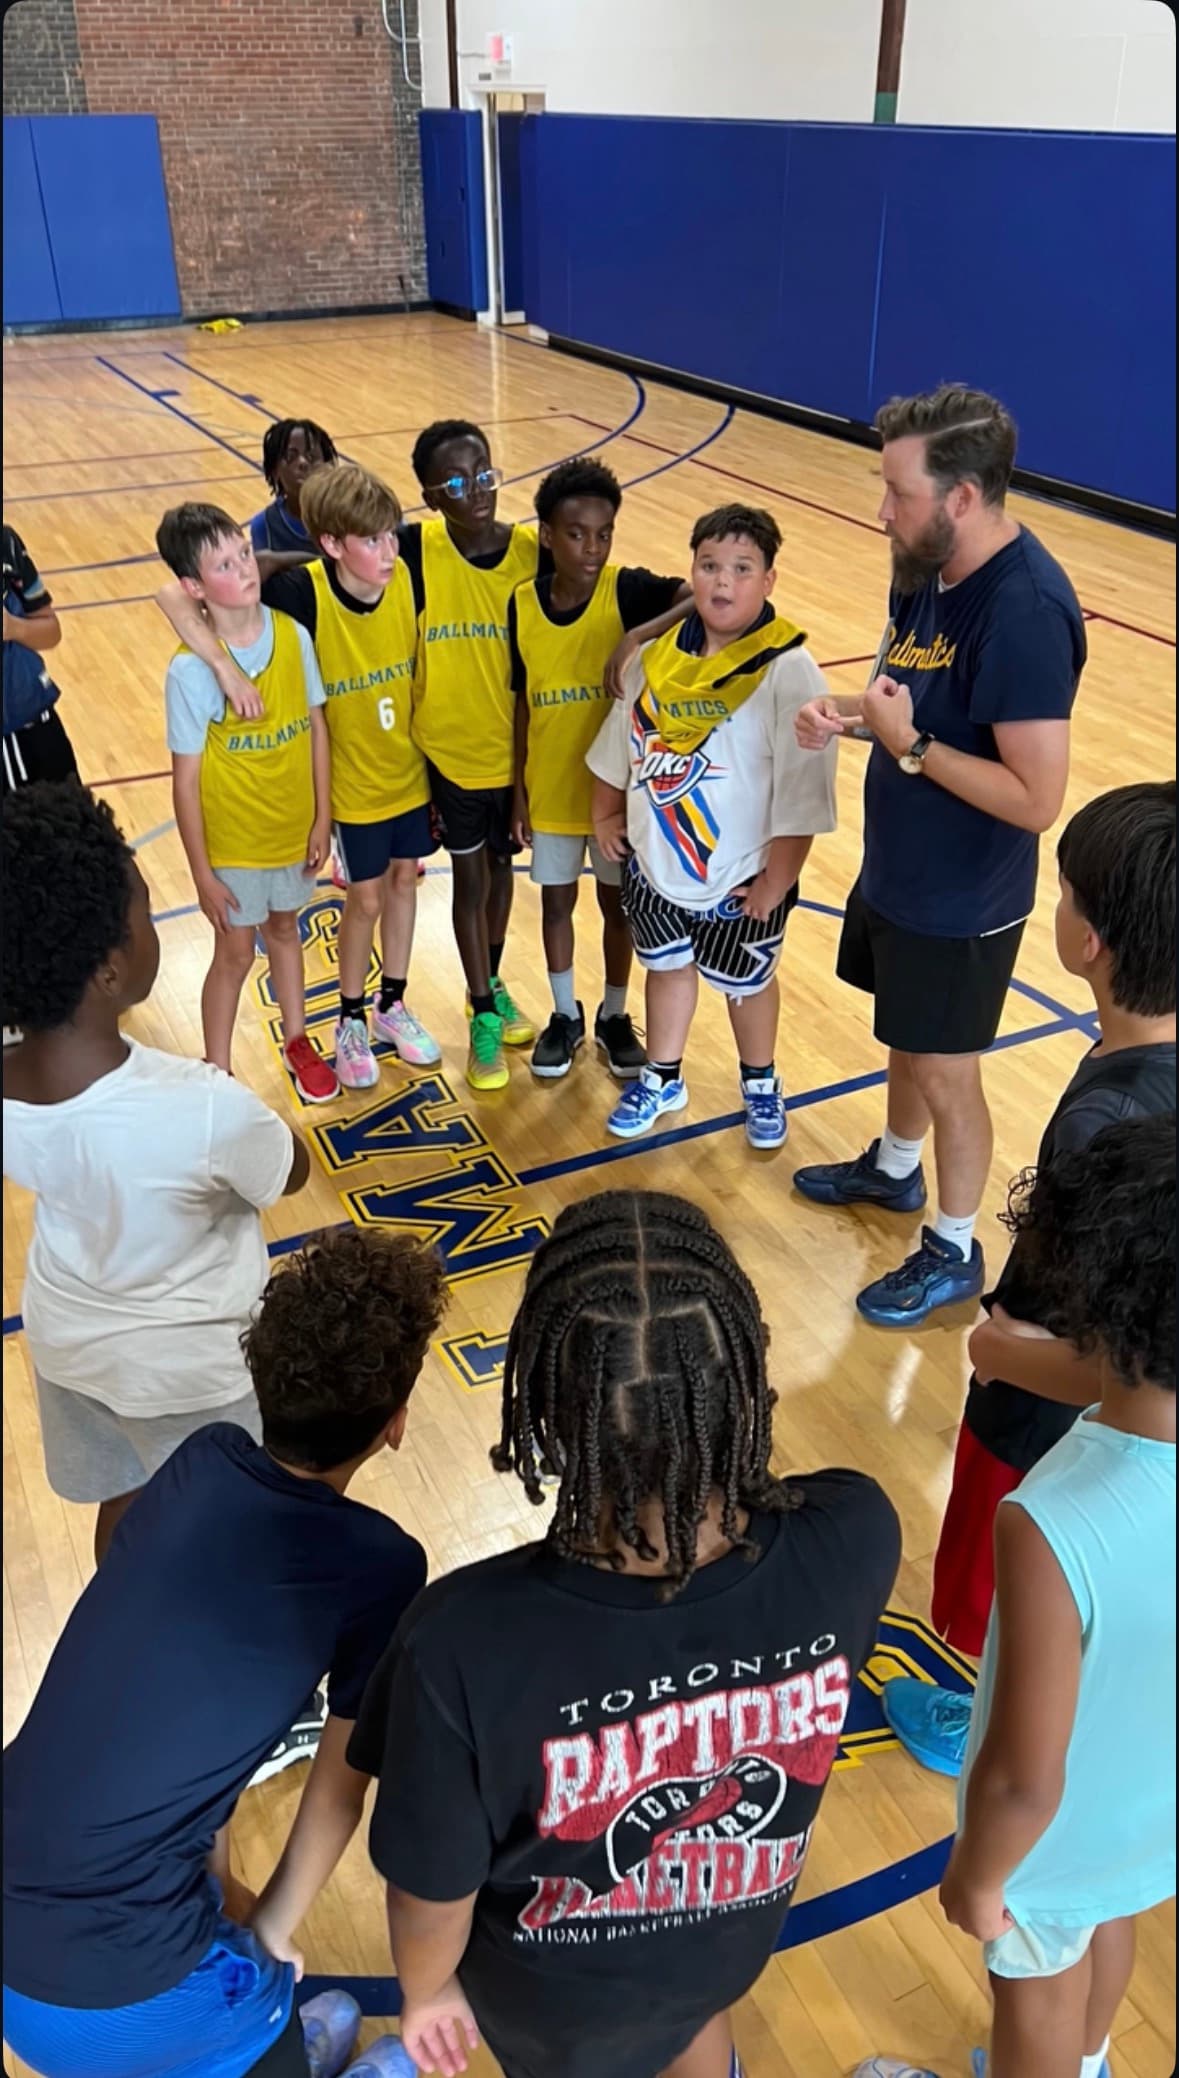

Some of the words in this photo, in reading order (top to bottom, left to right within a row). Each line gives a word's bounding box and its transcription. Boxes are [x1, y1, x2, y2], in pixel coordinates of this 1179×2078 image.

[377, 696, 396, 731] 6
[663, 699, 729, 718] ATICS
[559, 1632, 838, 1726] TORONTO
[540, 1655, 850, 1832] RAPTORS
